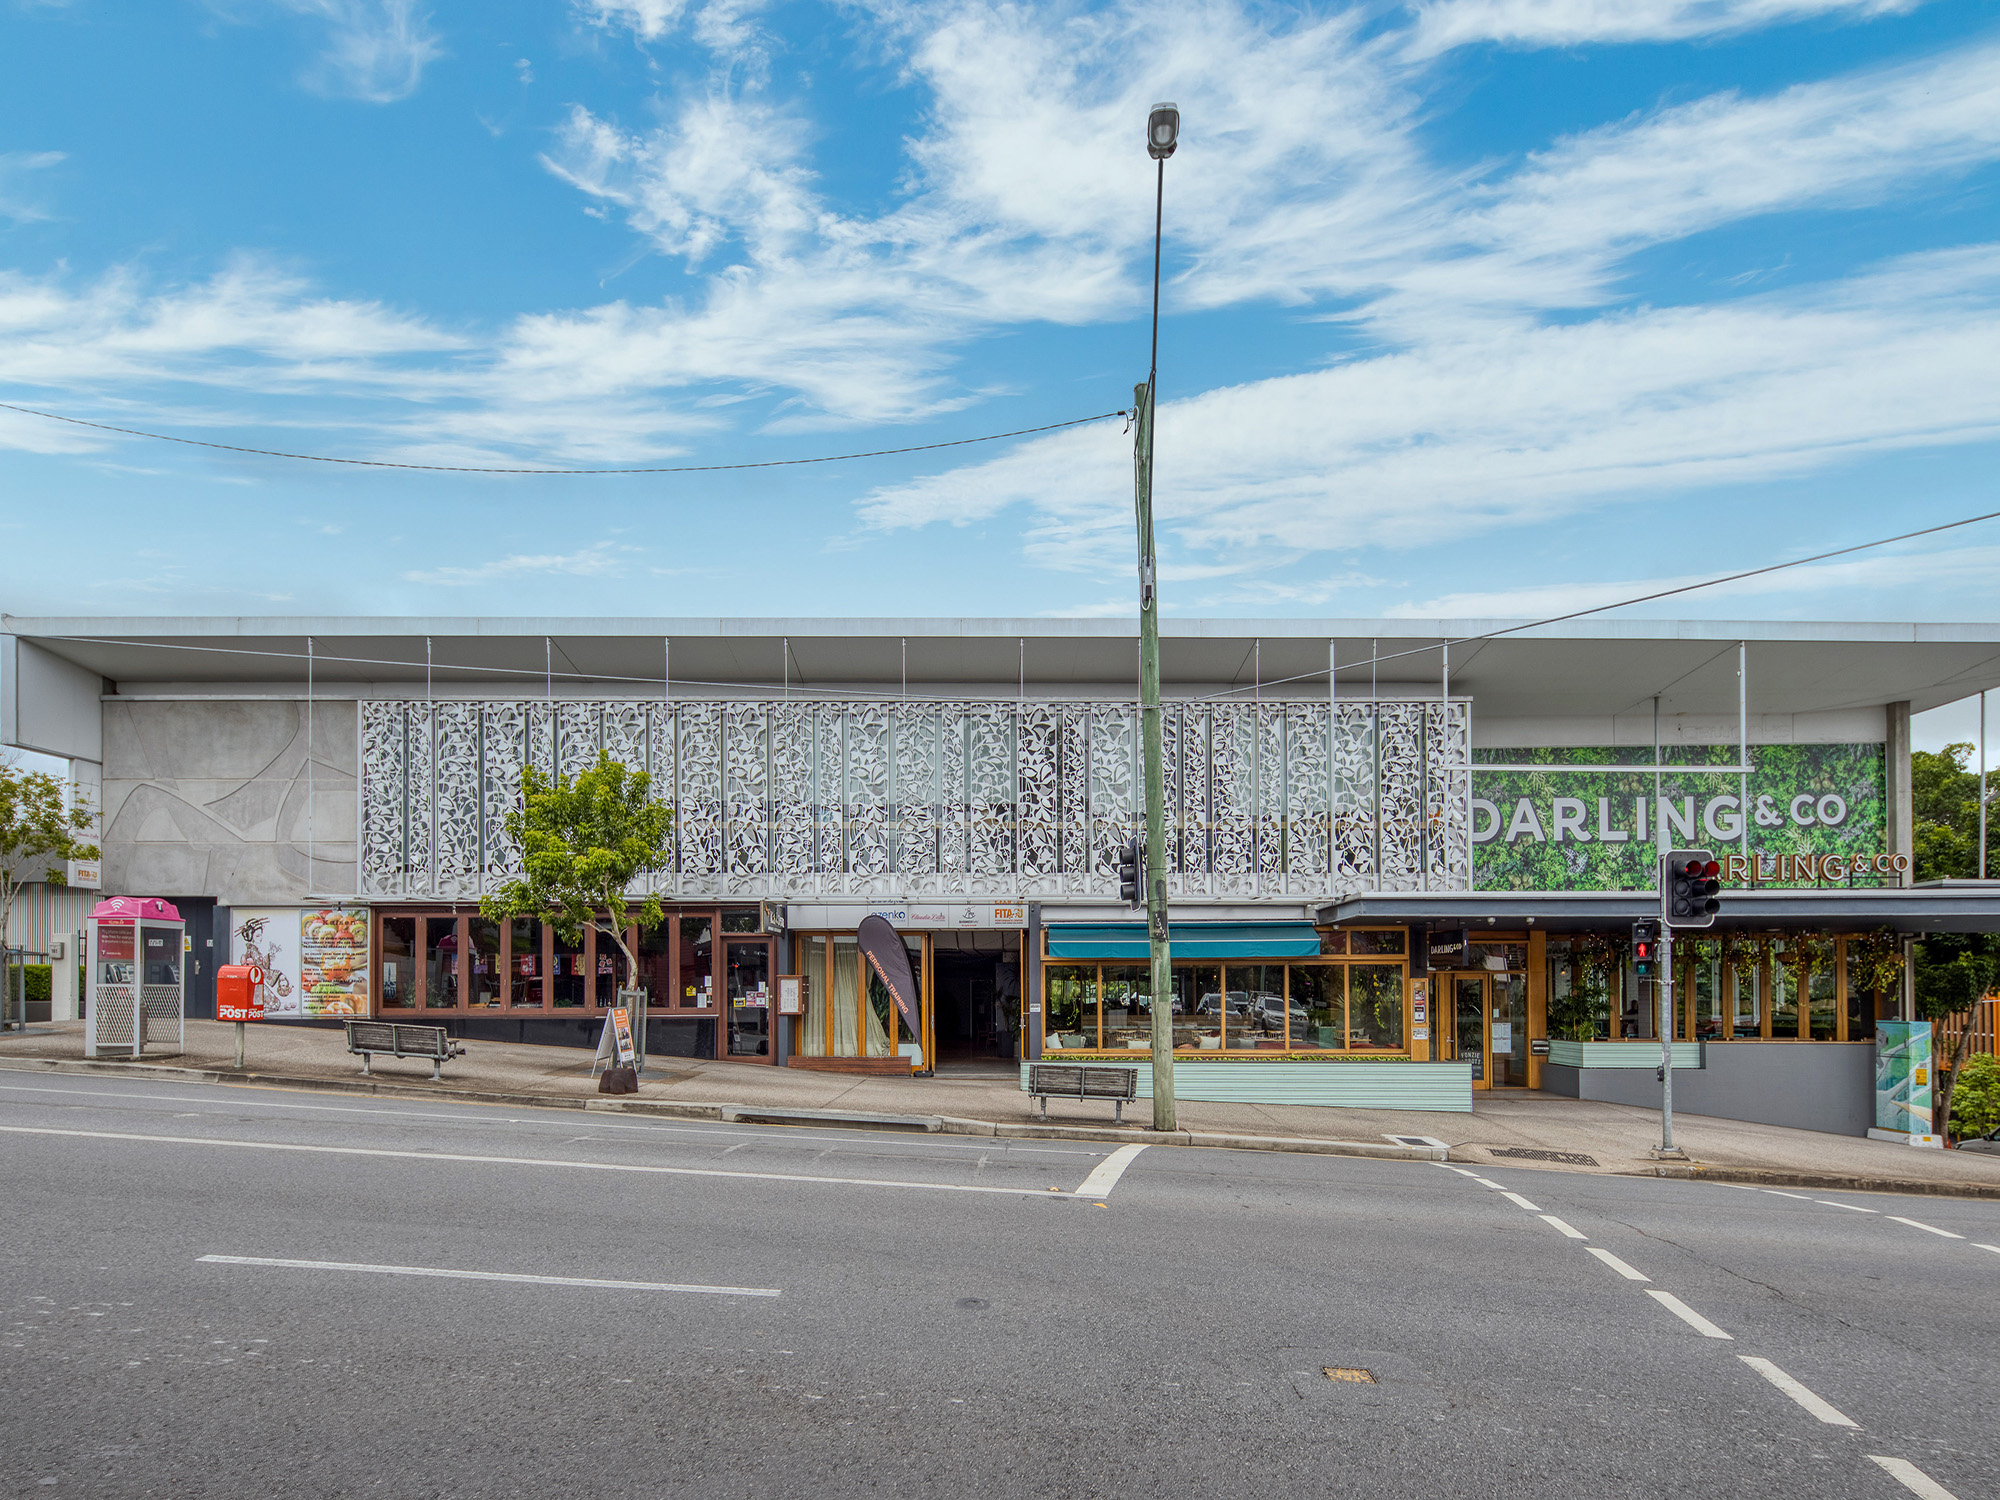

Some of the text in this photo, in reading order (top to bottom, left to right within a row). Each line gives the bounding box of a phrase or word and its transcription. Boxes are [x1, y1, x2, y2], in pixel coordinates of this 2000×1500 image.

[866, 950, 909, 1014] PERSONAL TRAINING
[219, 1008, 264, 1019] POST POST
